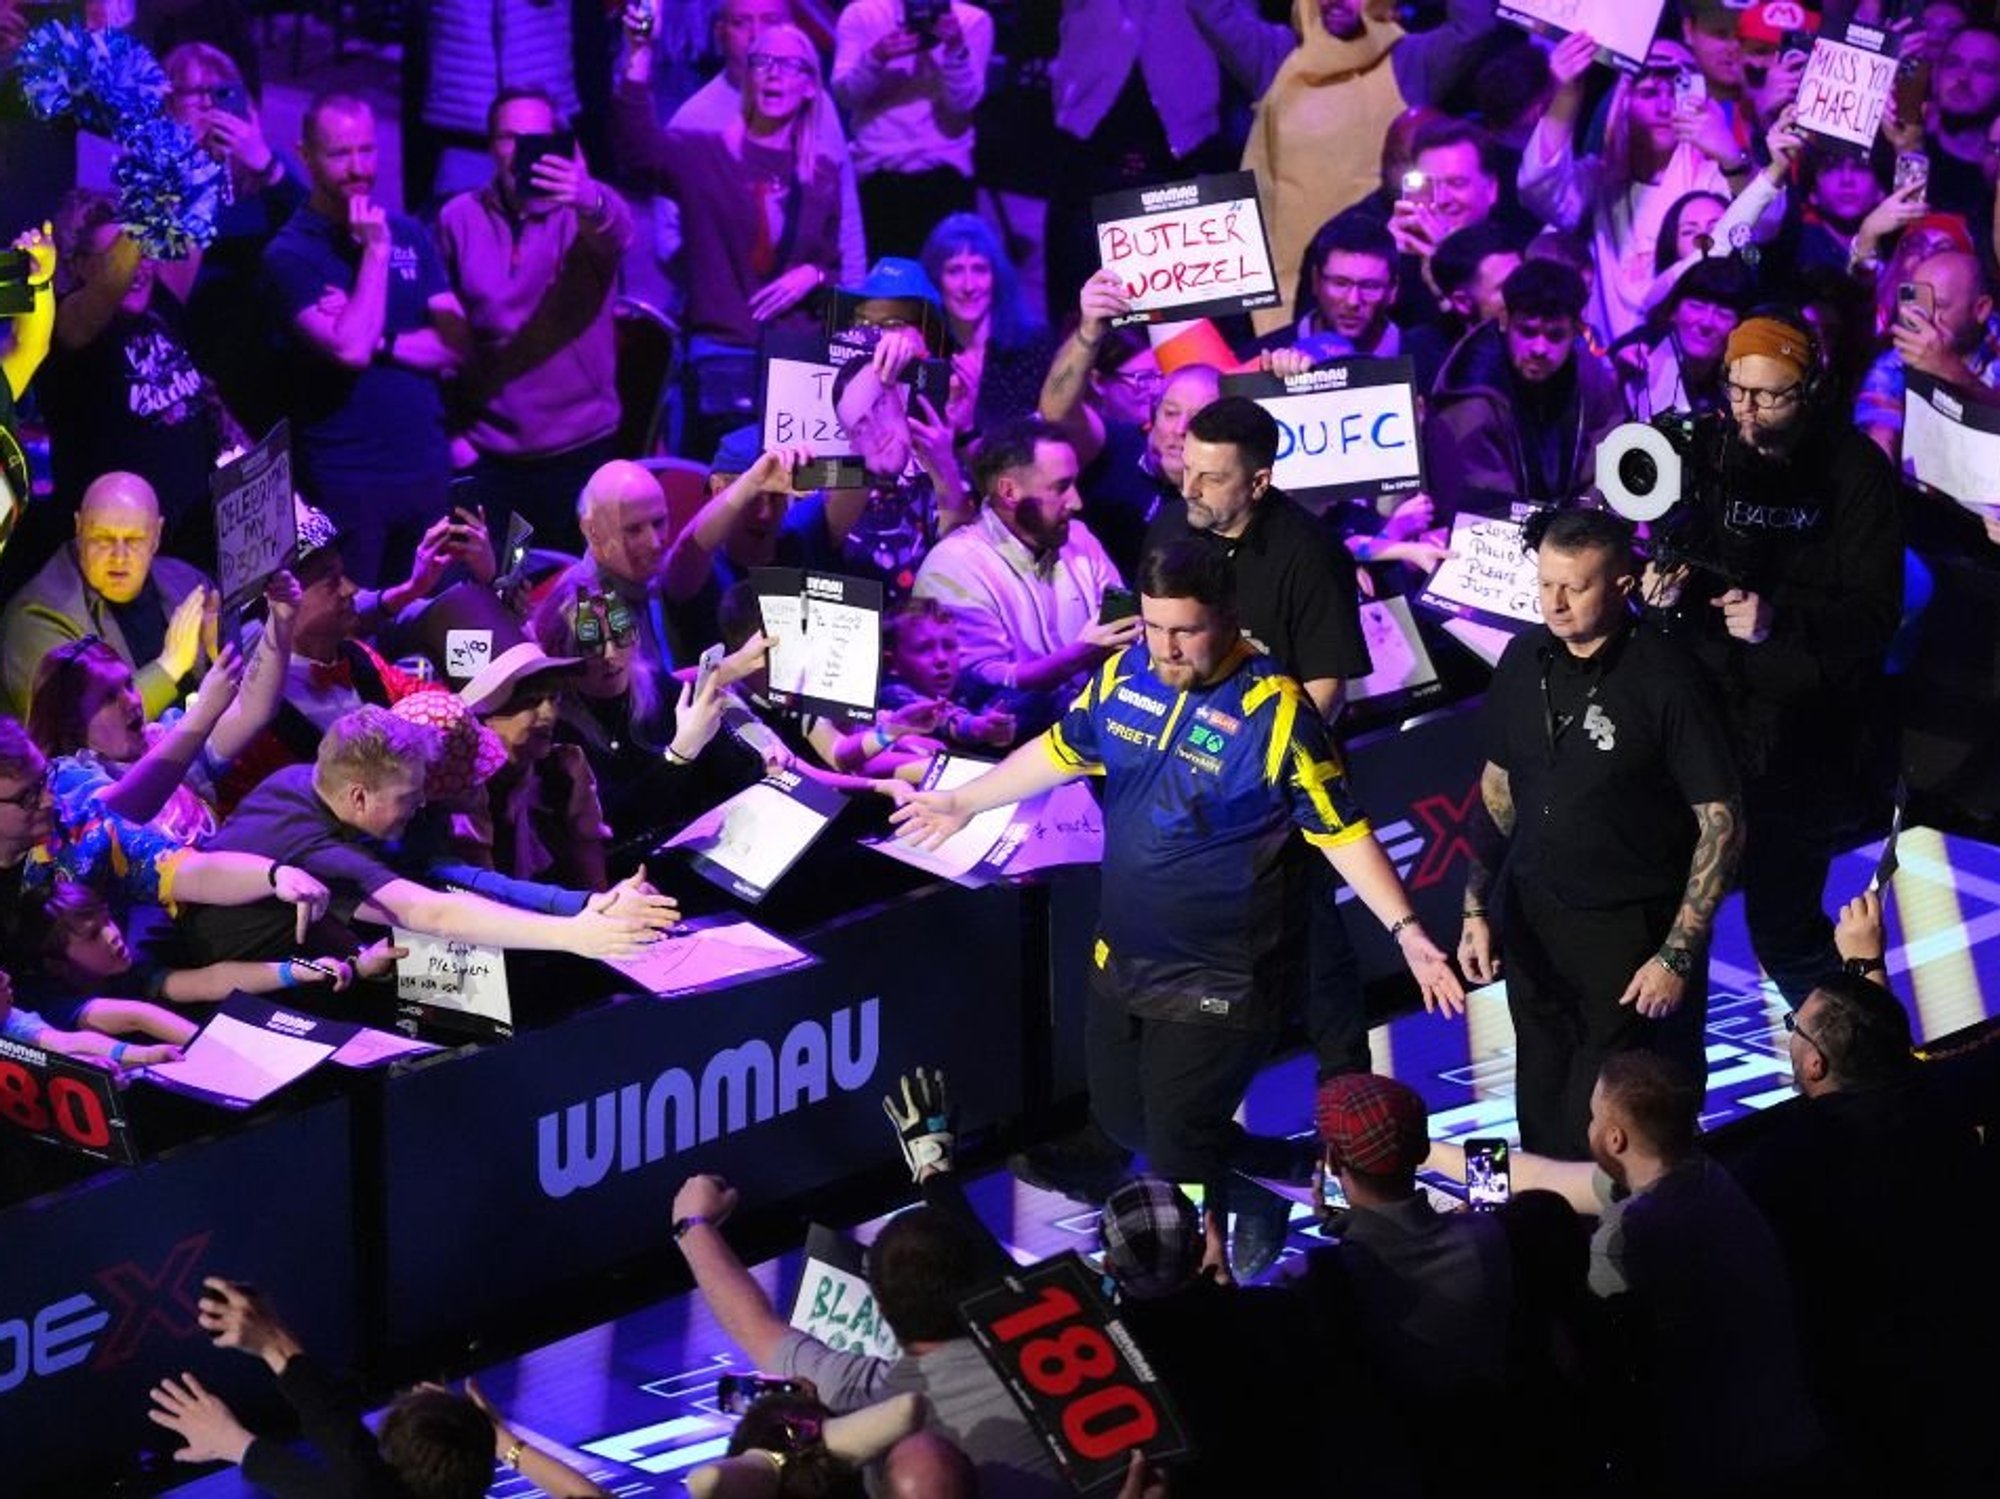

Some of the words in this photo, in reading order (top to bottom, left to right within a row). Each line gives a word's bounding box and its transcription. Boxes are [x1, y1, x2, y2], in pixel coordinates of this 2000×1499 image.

[1868, 59, 1889, 91] YO
[1101, 213, 1246, 262] BUTLER
[538, 998, 880, 1198] WINMAU
[990, 1285, 1159, 1460] 180
